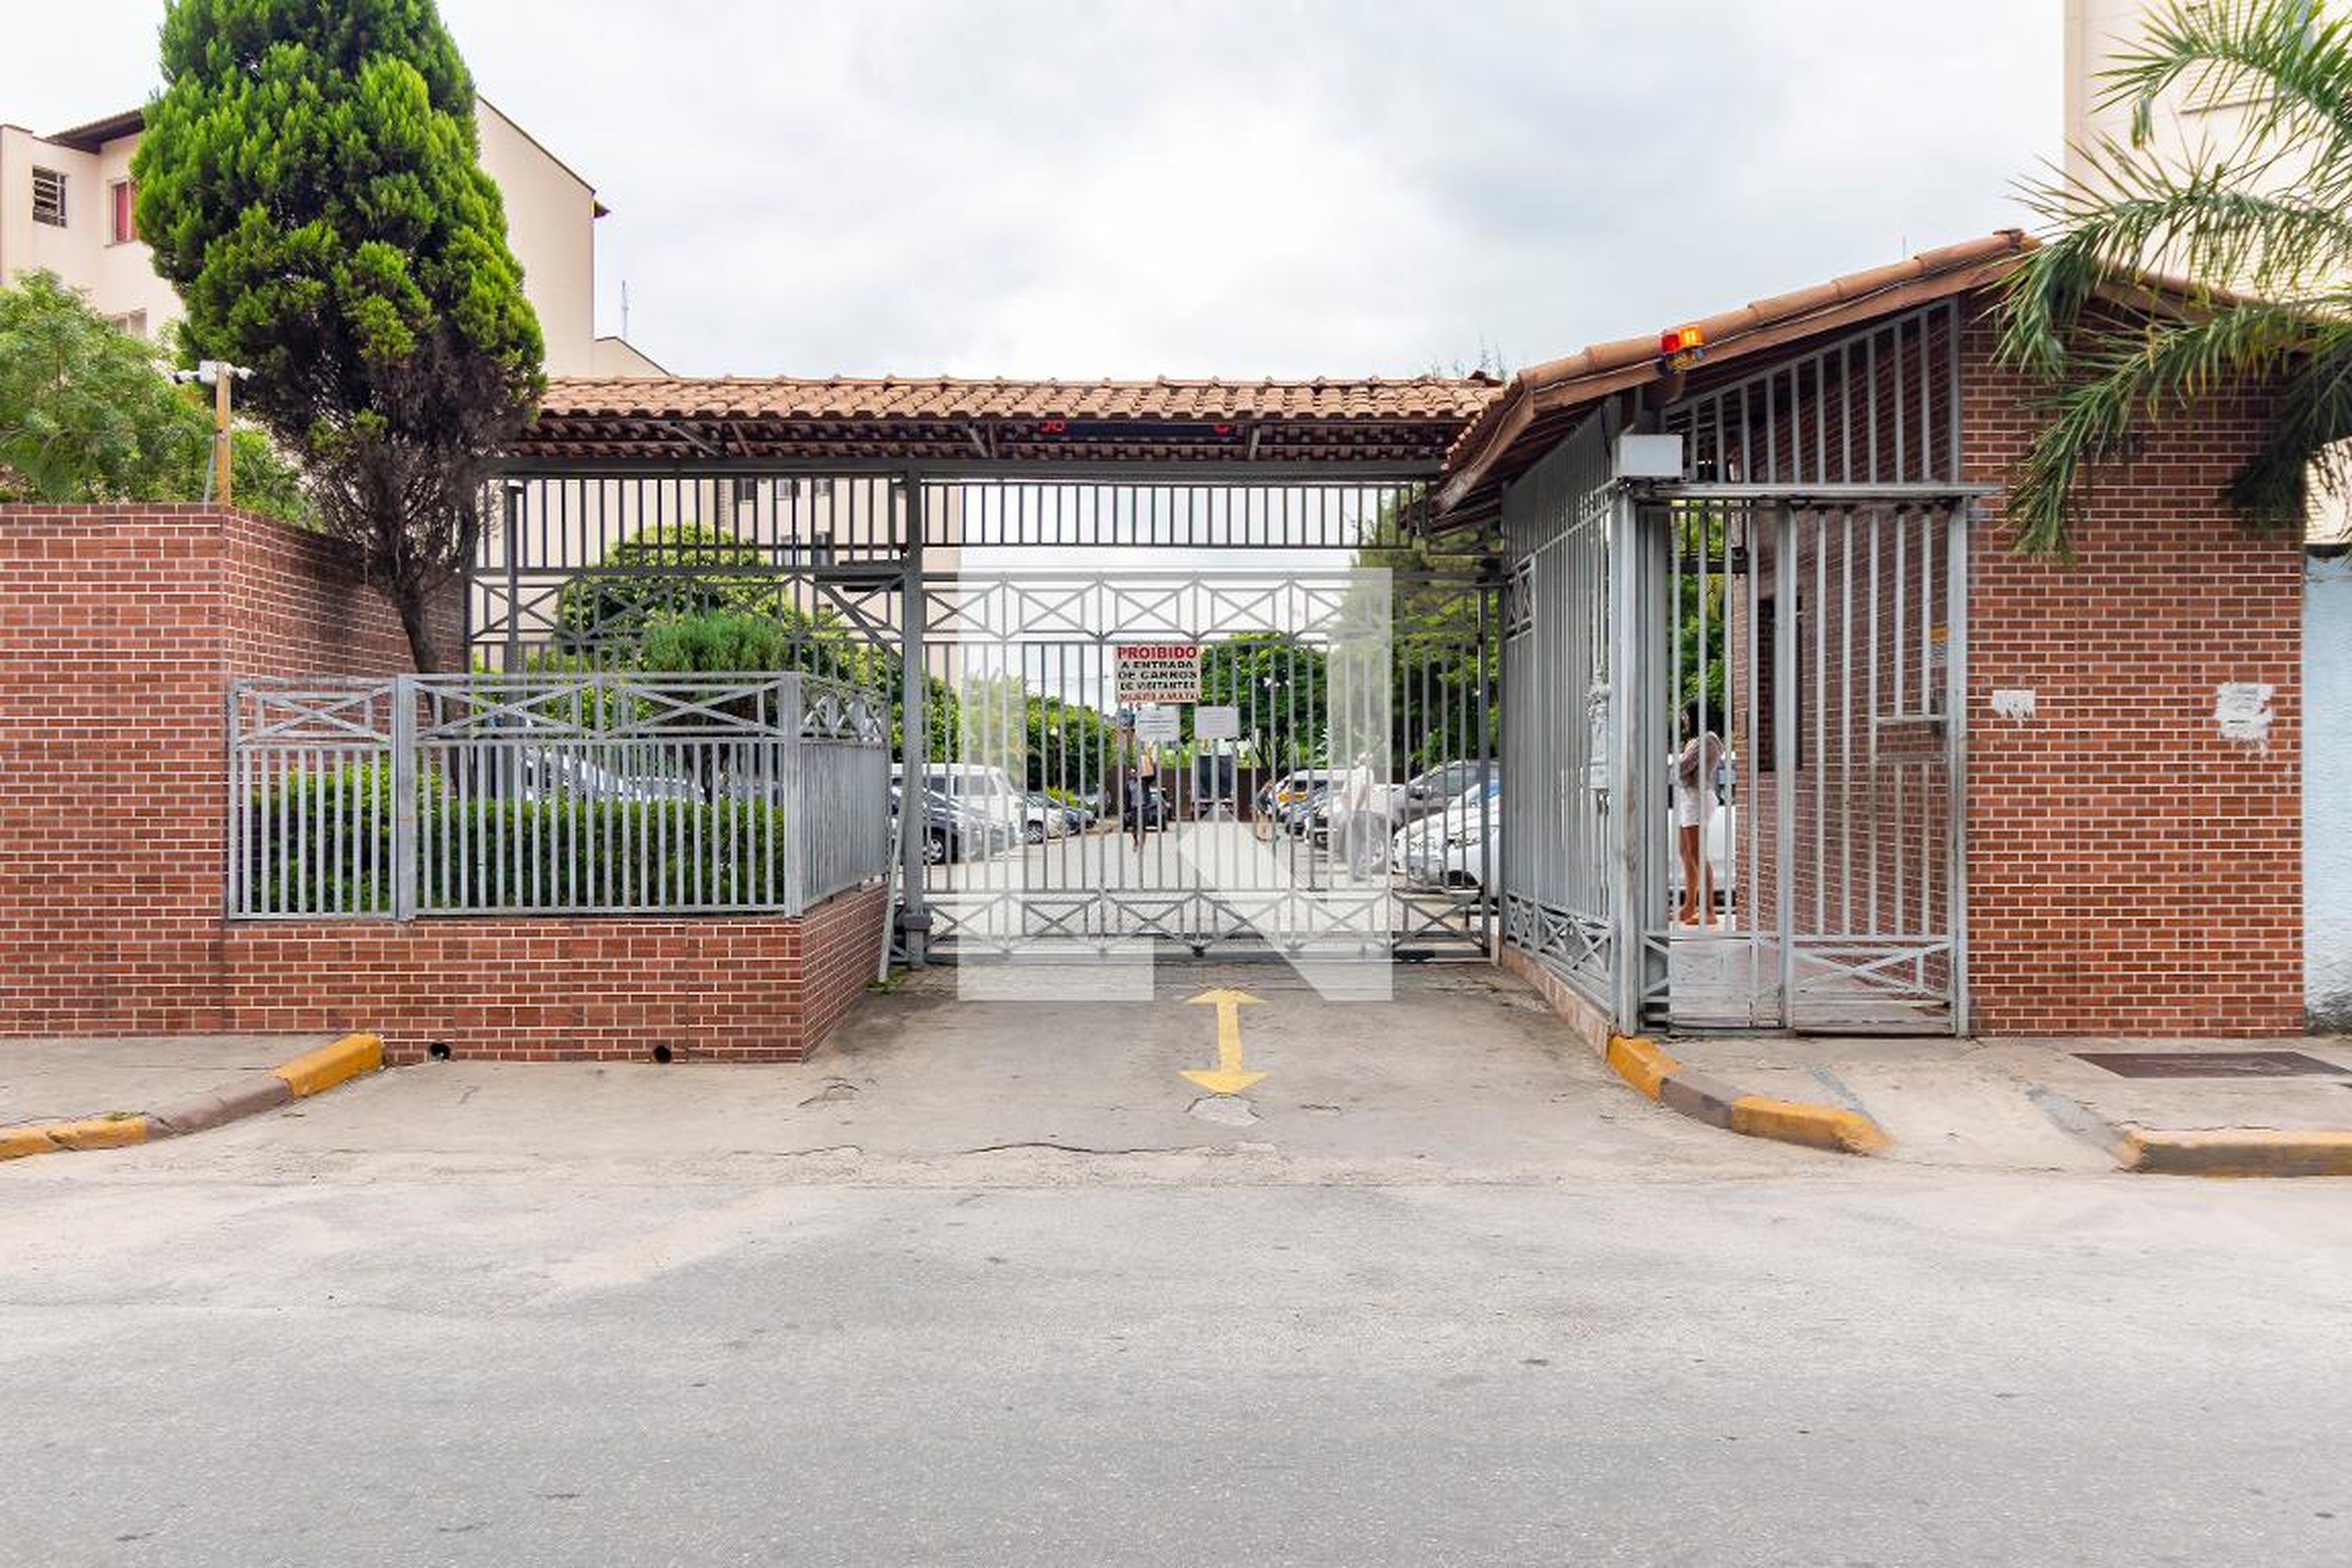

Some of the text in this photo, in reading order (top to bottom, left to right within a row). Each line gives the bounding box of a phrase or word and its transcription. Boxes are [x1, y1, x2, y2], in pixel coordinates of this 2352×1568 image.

[1118, 647, 1197, 659] PROIBIDO
[1118, 671, 1197, 680] DE CARROS
[1137, 681, 1196, 690] VISITANTES
